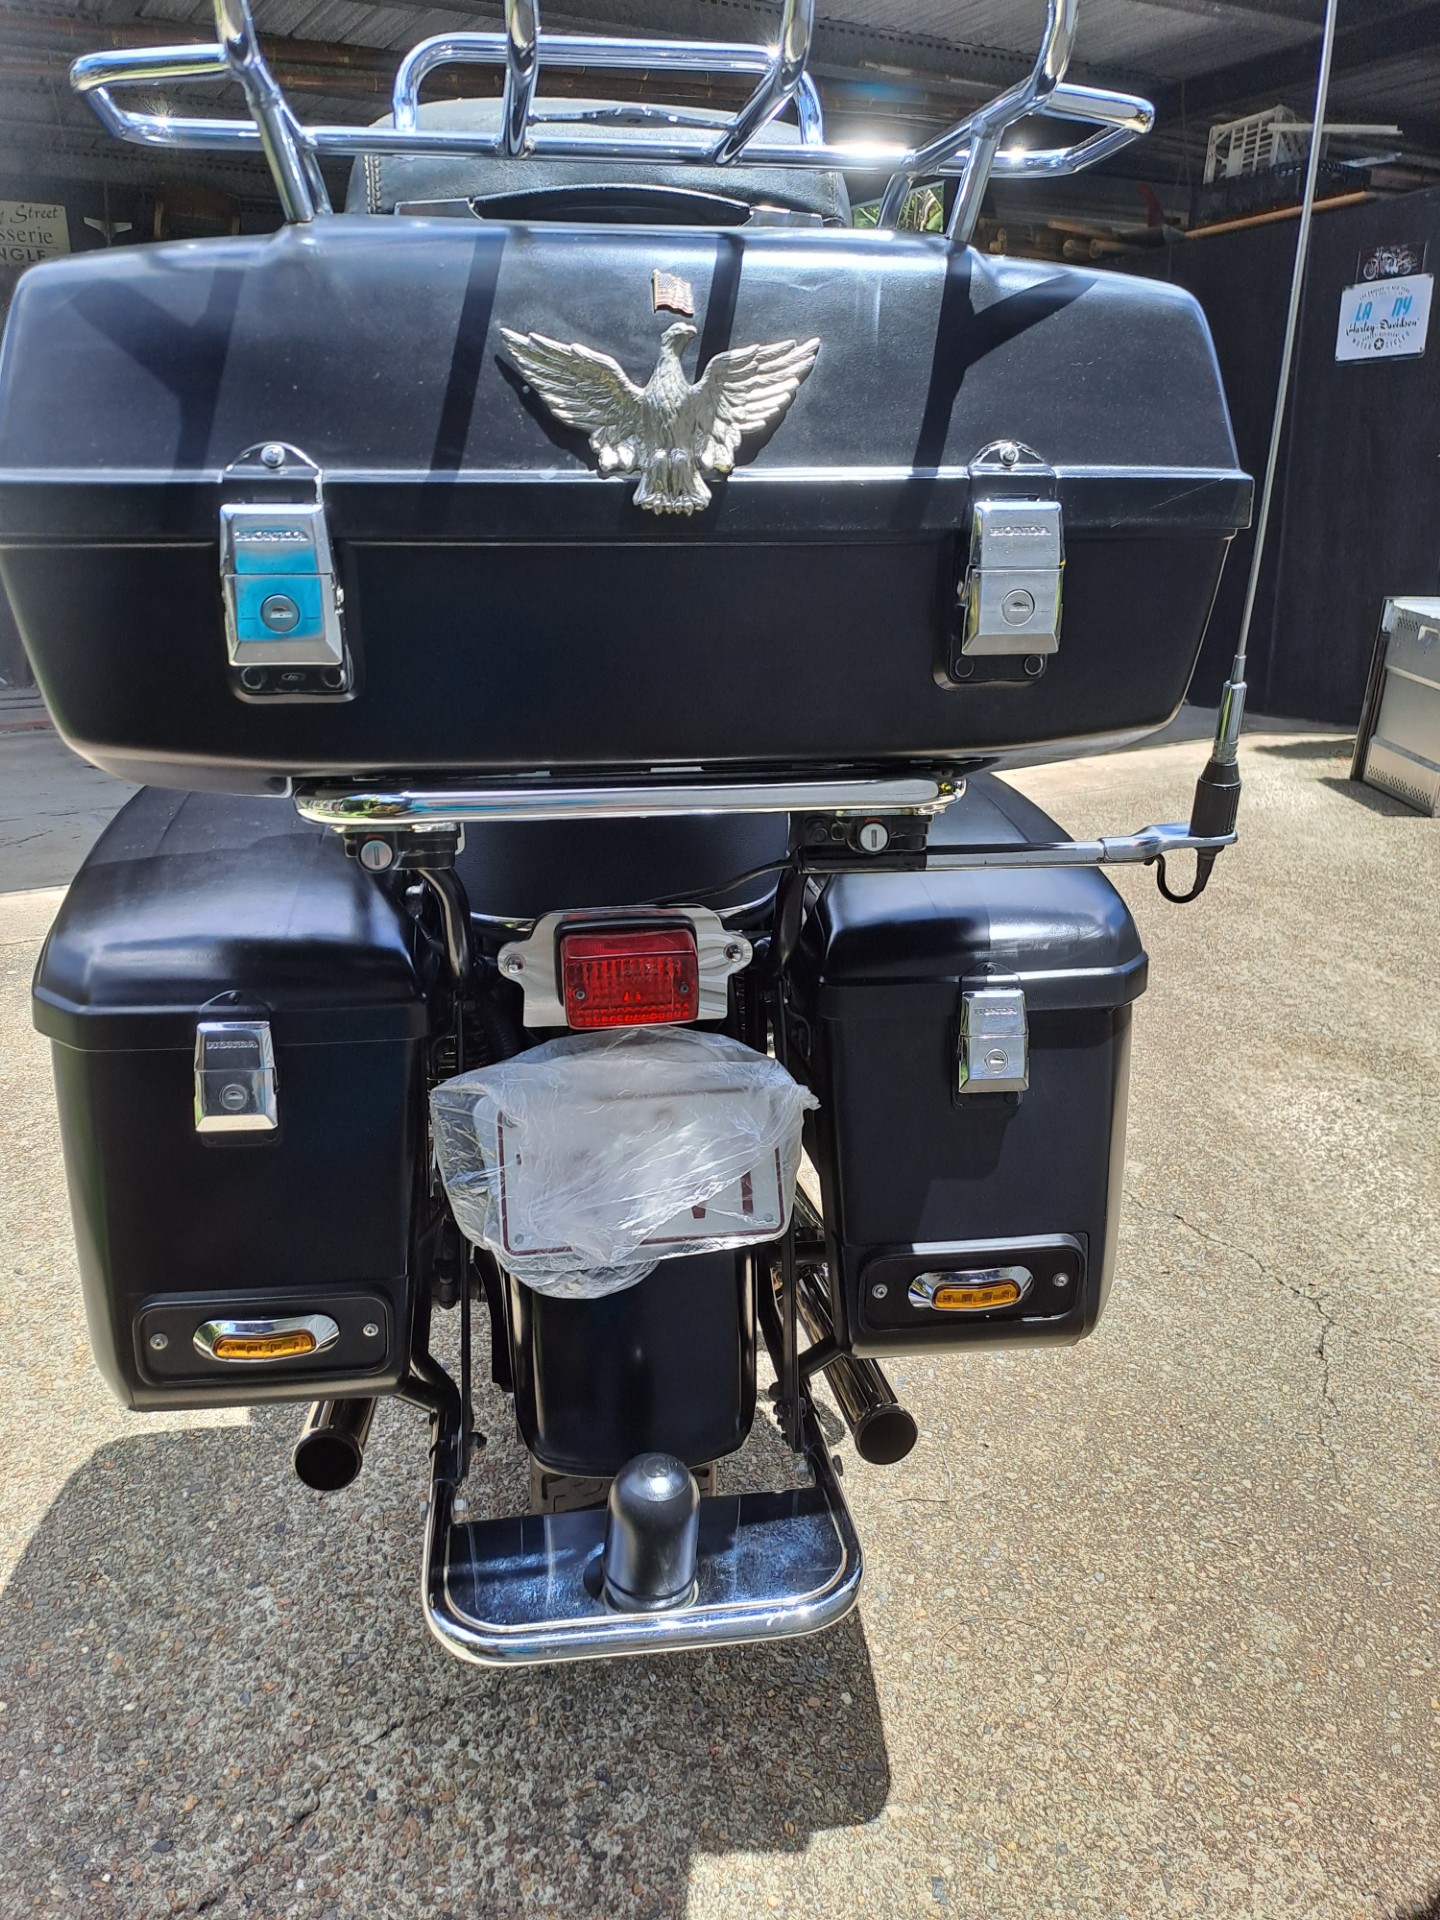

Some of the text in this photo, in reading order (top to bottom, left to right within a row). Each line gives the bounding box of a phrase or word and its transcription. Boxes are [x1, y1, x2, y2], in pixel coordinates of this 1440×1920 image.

[10, 204, 58, 223] Street
[1355, 295, 1413, 321] LA NY
[1345, 317, 1417, 336] Harley-Davidson
[989, 525, 1052, 537] HONDA
[206, 1040, 259, 1049] HONDA
